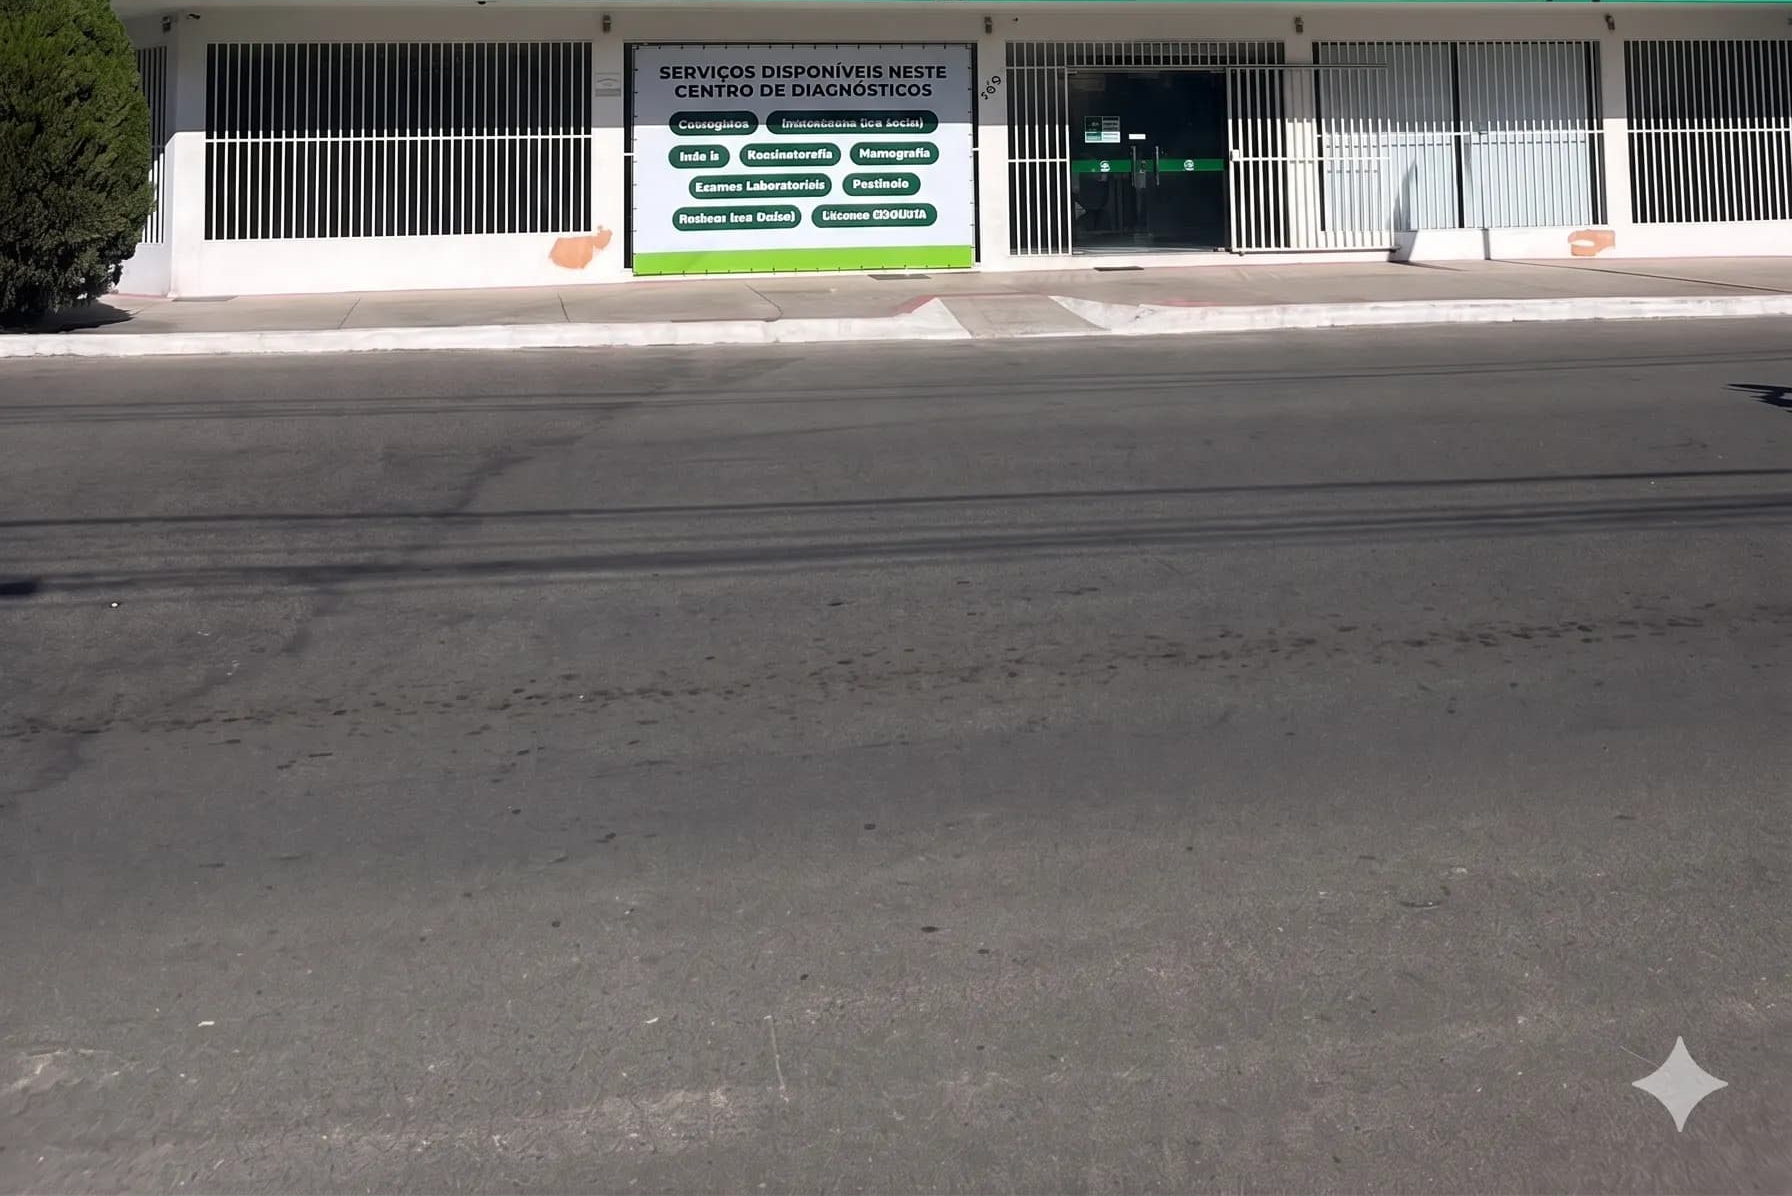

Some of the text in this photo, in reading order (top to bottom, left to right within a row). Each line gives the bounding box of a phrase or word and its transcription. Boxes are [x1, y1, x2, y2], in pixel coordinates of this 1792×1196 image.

[659, 62, 947, 82] SERVIÇOS DISPONÍVEIS NESTE
[674, 80, 933, 98] CENTRO DE DIAGNÓSTICOS
